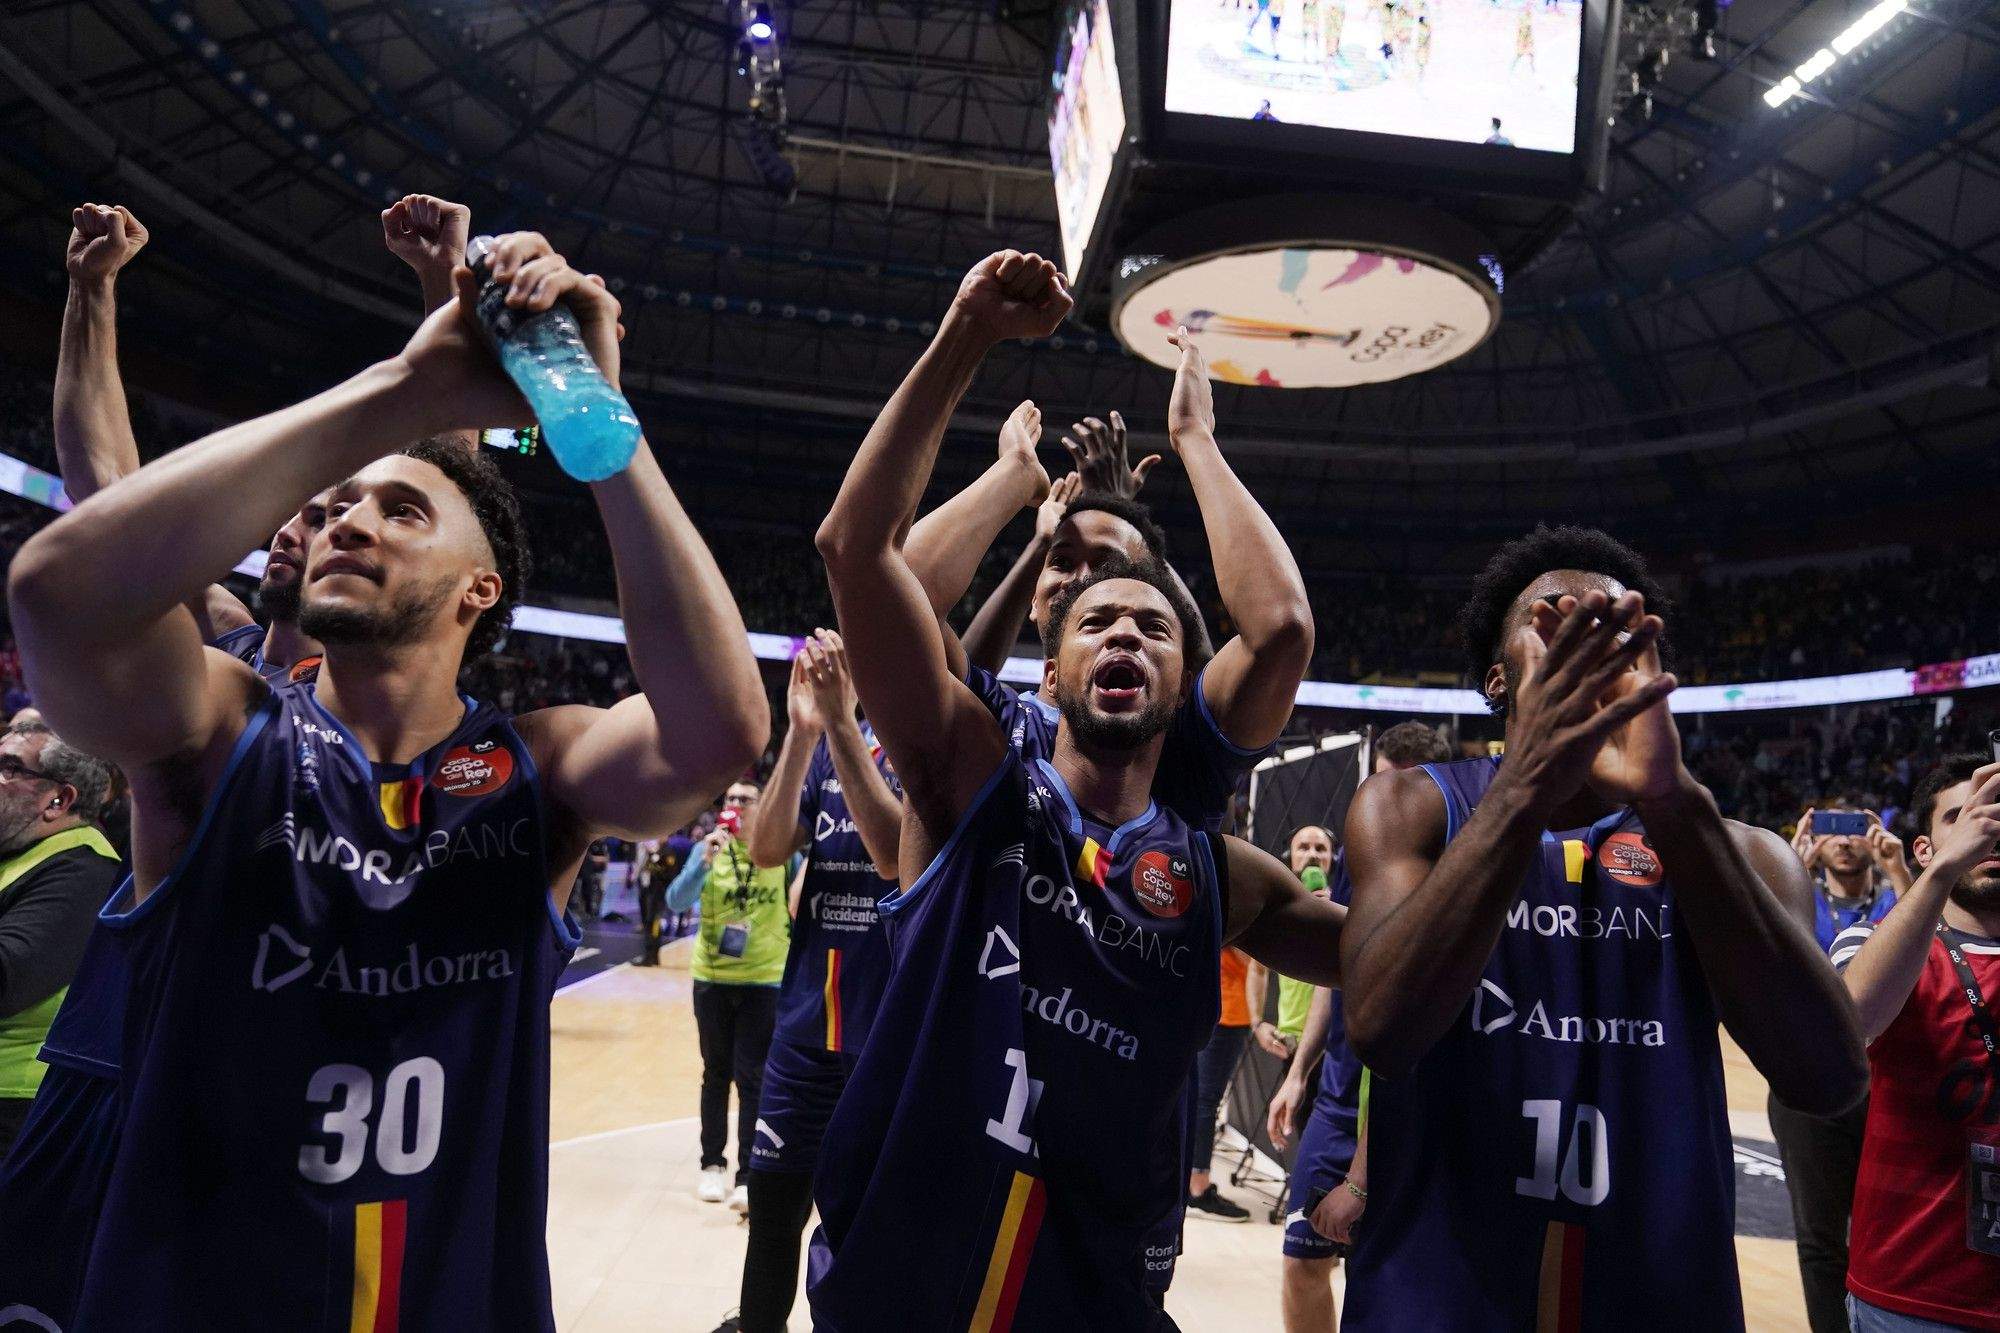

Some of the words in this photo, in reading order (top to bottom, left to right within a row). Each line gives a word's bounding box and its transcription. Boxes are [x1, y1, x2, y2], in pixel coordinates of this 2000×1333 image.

[1350, 326, 1409, 362] Copa
[441, 759, 484, 775] Copa
[464, 766, 493, 780] Rey
[1613, 848, 1651, 860] Copa
[1149, 867, 1165, 879] acb
[1631, 860, 1656, 872] Rey
[1143, 871, 1172, 891] Copa
[823, 891, 875, 908] Catalana
[1155, 888, 1175, 904] Rey
[821, 907, 879, 924] Occidente
[1021, 864, 1190, 977] ORABANC
[313, 942, 514, 997] Andorra
[1966, 988, 1978, 1005] acb
[1019, 983, 1140, 1060] ndorra
[298, 1055, 446, 1185] 30
[1515, 1099, 1611, 1207] 10
